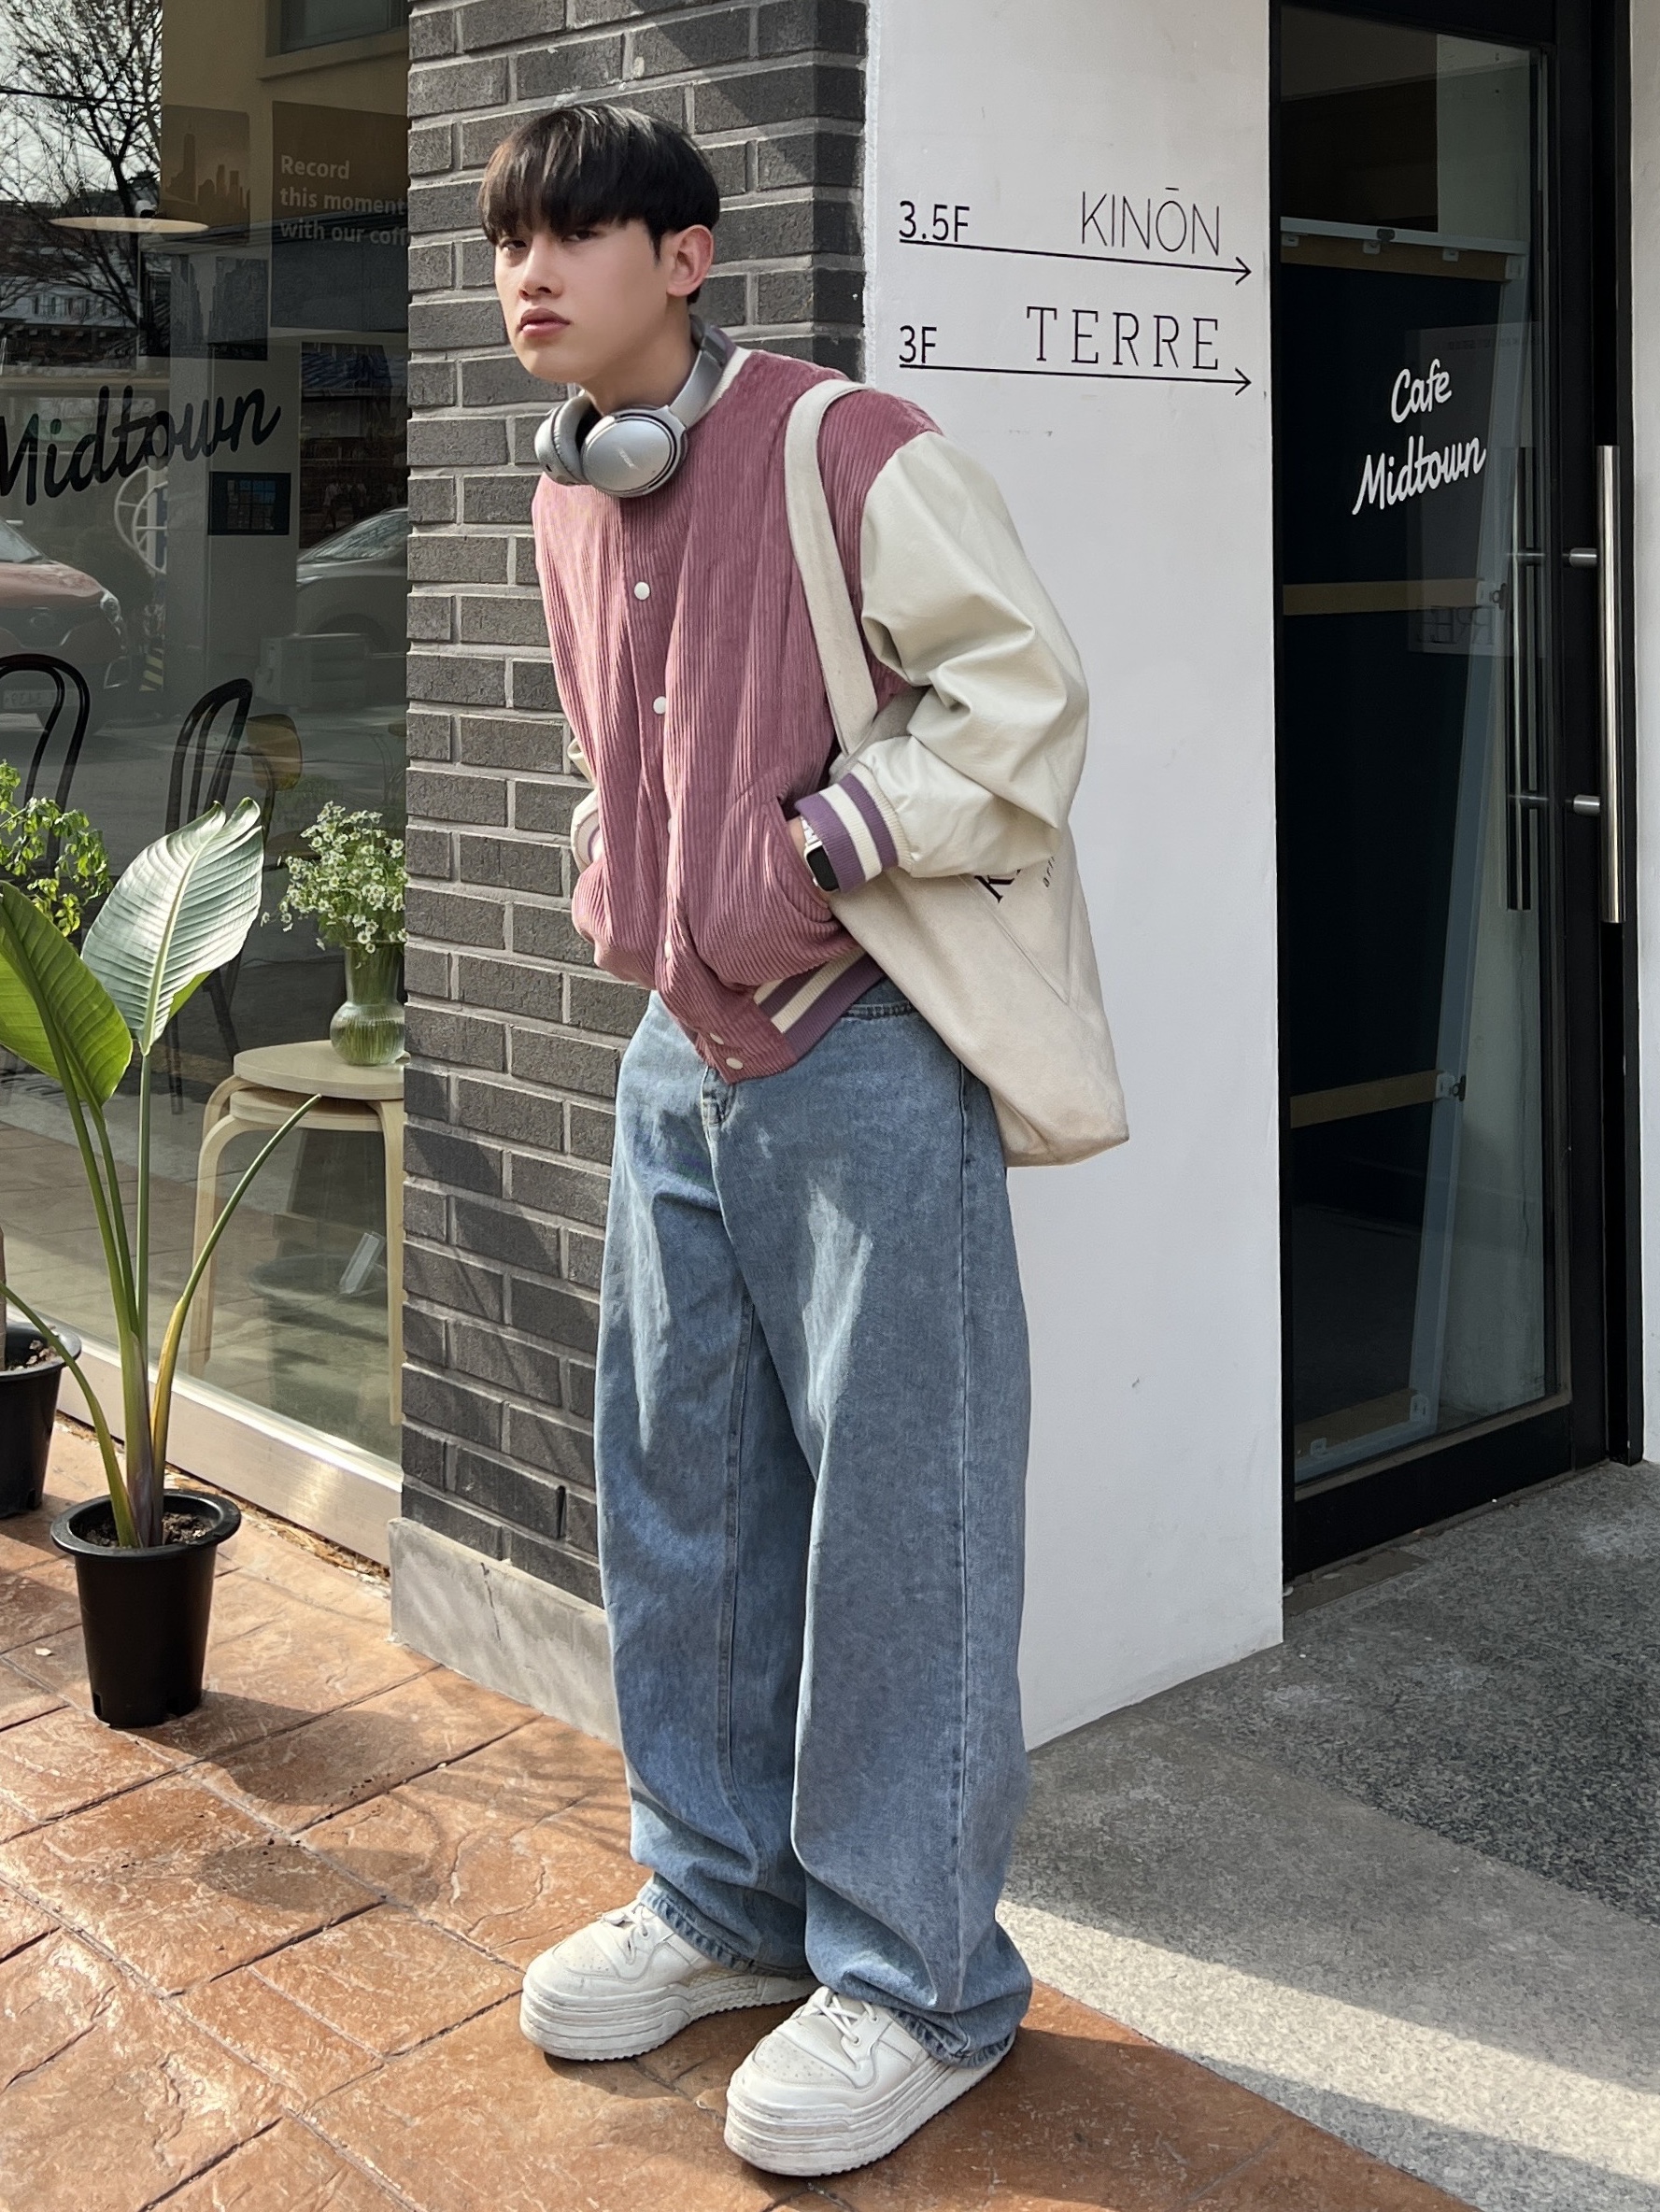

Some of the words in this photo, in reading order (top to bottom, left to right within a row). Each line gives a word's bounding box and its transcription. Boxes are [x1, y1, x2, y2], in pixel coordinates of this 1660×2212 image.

[281, 154, 350, 180] Record
[280, 187, 318, 208] this
[324, 194, 407, 216] moment
[280, 219, 325, 240] with
[332, 226, 365, 243] our
[369, 226, 410, 247] coff
[899, 200, 971, 243] 3.5F
[1082, 187, 1220, 256] KINŌN
[899, 325, 938, 364] 3F
[1027, 305, 1219, 370] TERRE
[1391, 358, 1453, 423] Cafe
[1352, 435, 1487, 515] Midtown
